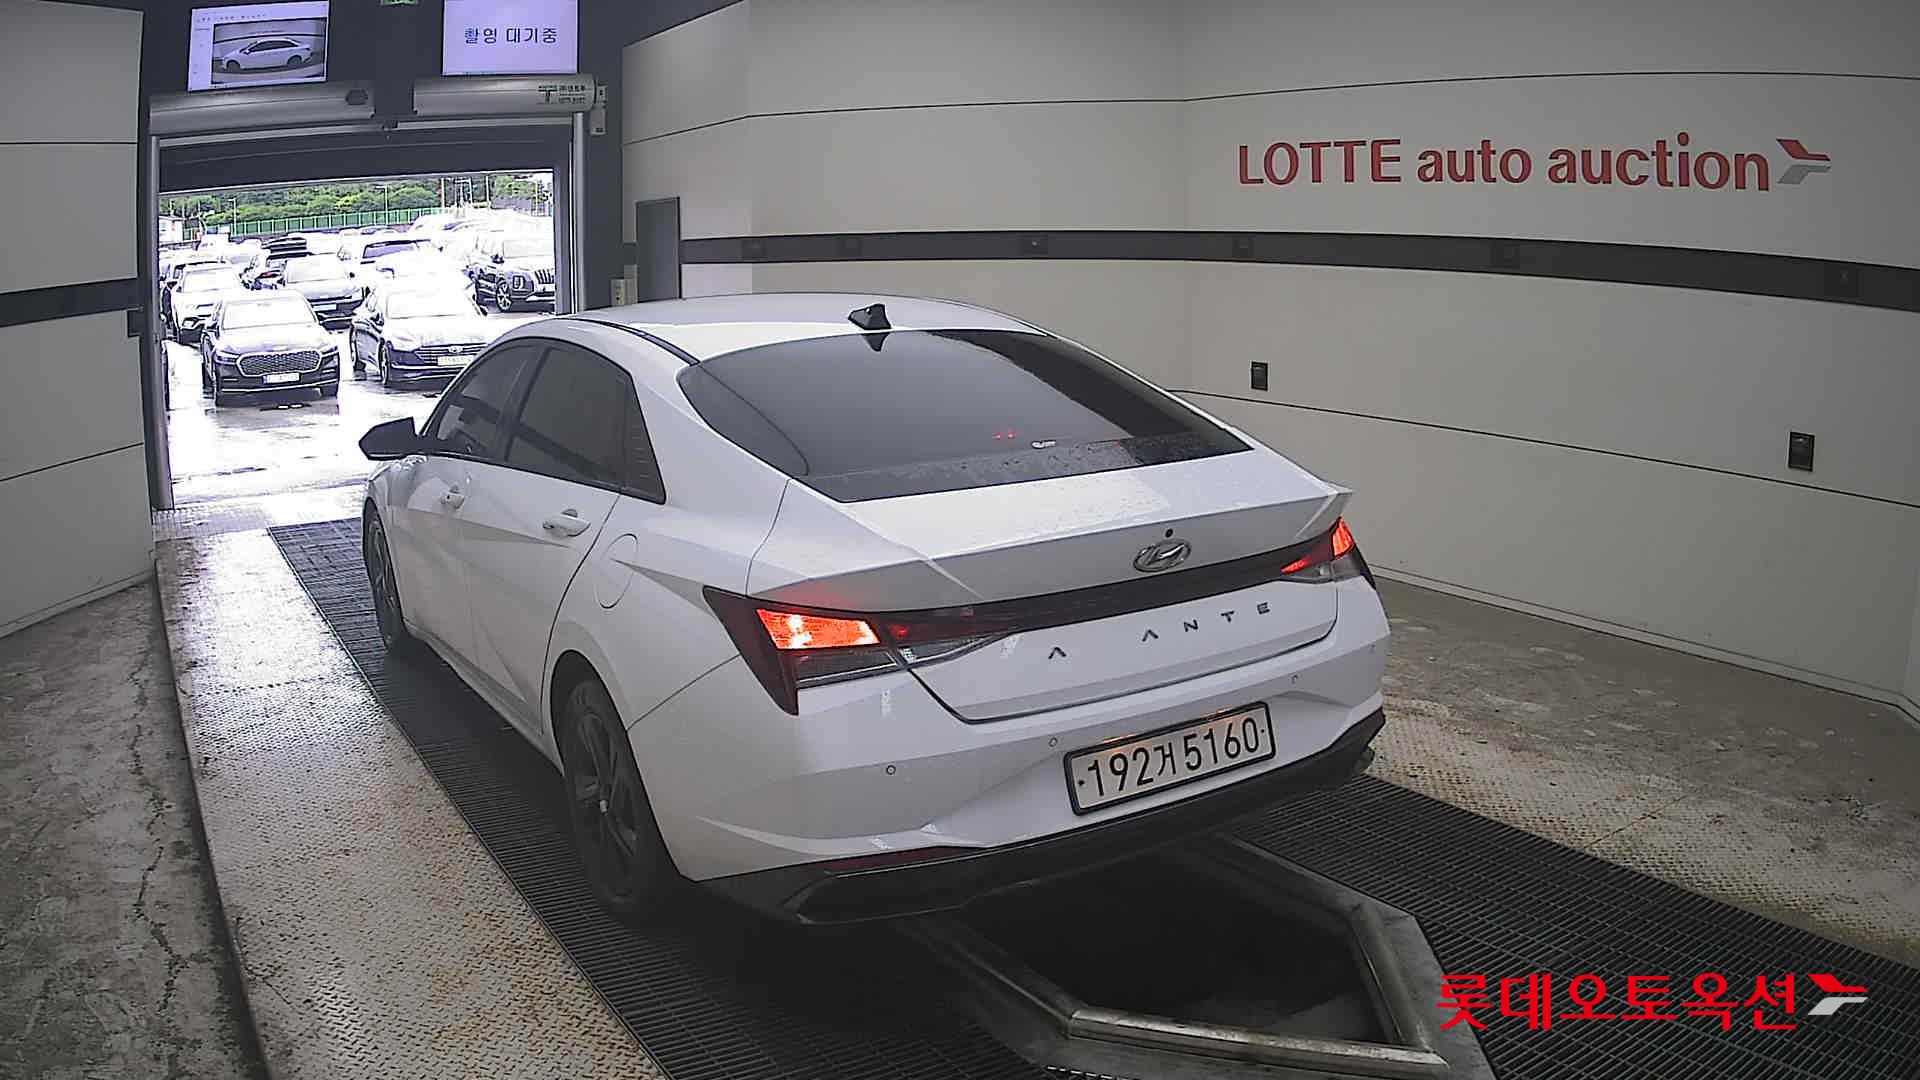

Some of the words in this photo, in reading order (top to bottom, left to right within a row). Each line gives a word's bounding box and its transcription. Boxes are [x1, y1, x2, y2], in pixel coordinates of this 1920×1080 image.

[464, 27, 498, 44] 촬영
[506, 27, 558, 44] 대기중
[1239, 140, 1401, 185] LOTTE
[1417, 139, 1532, 184] auto
[1548, 132, 1770, 192] auction
[1048, 602, 1271, 660] AANTE
